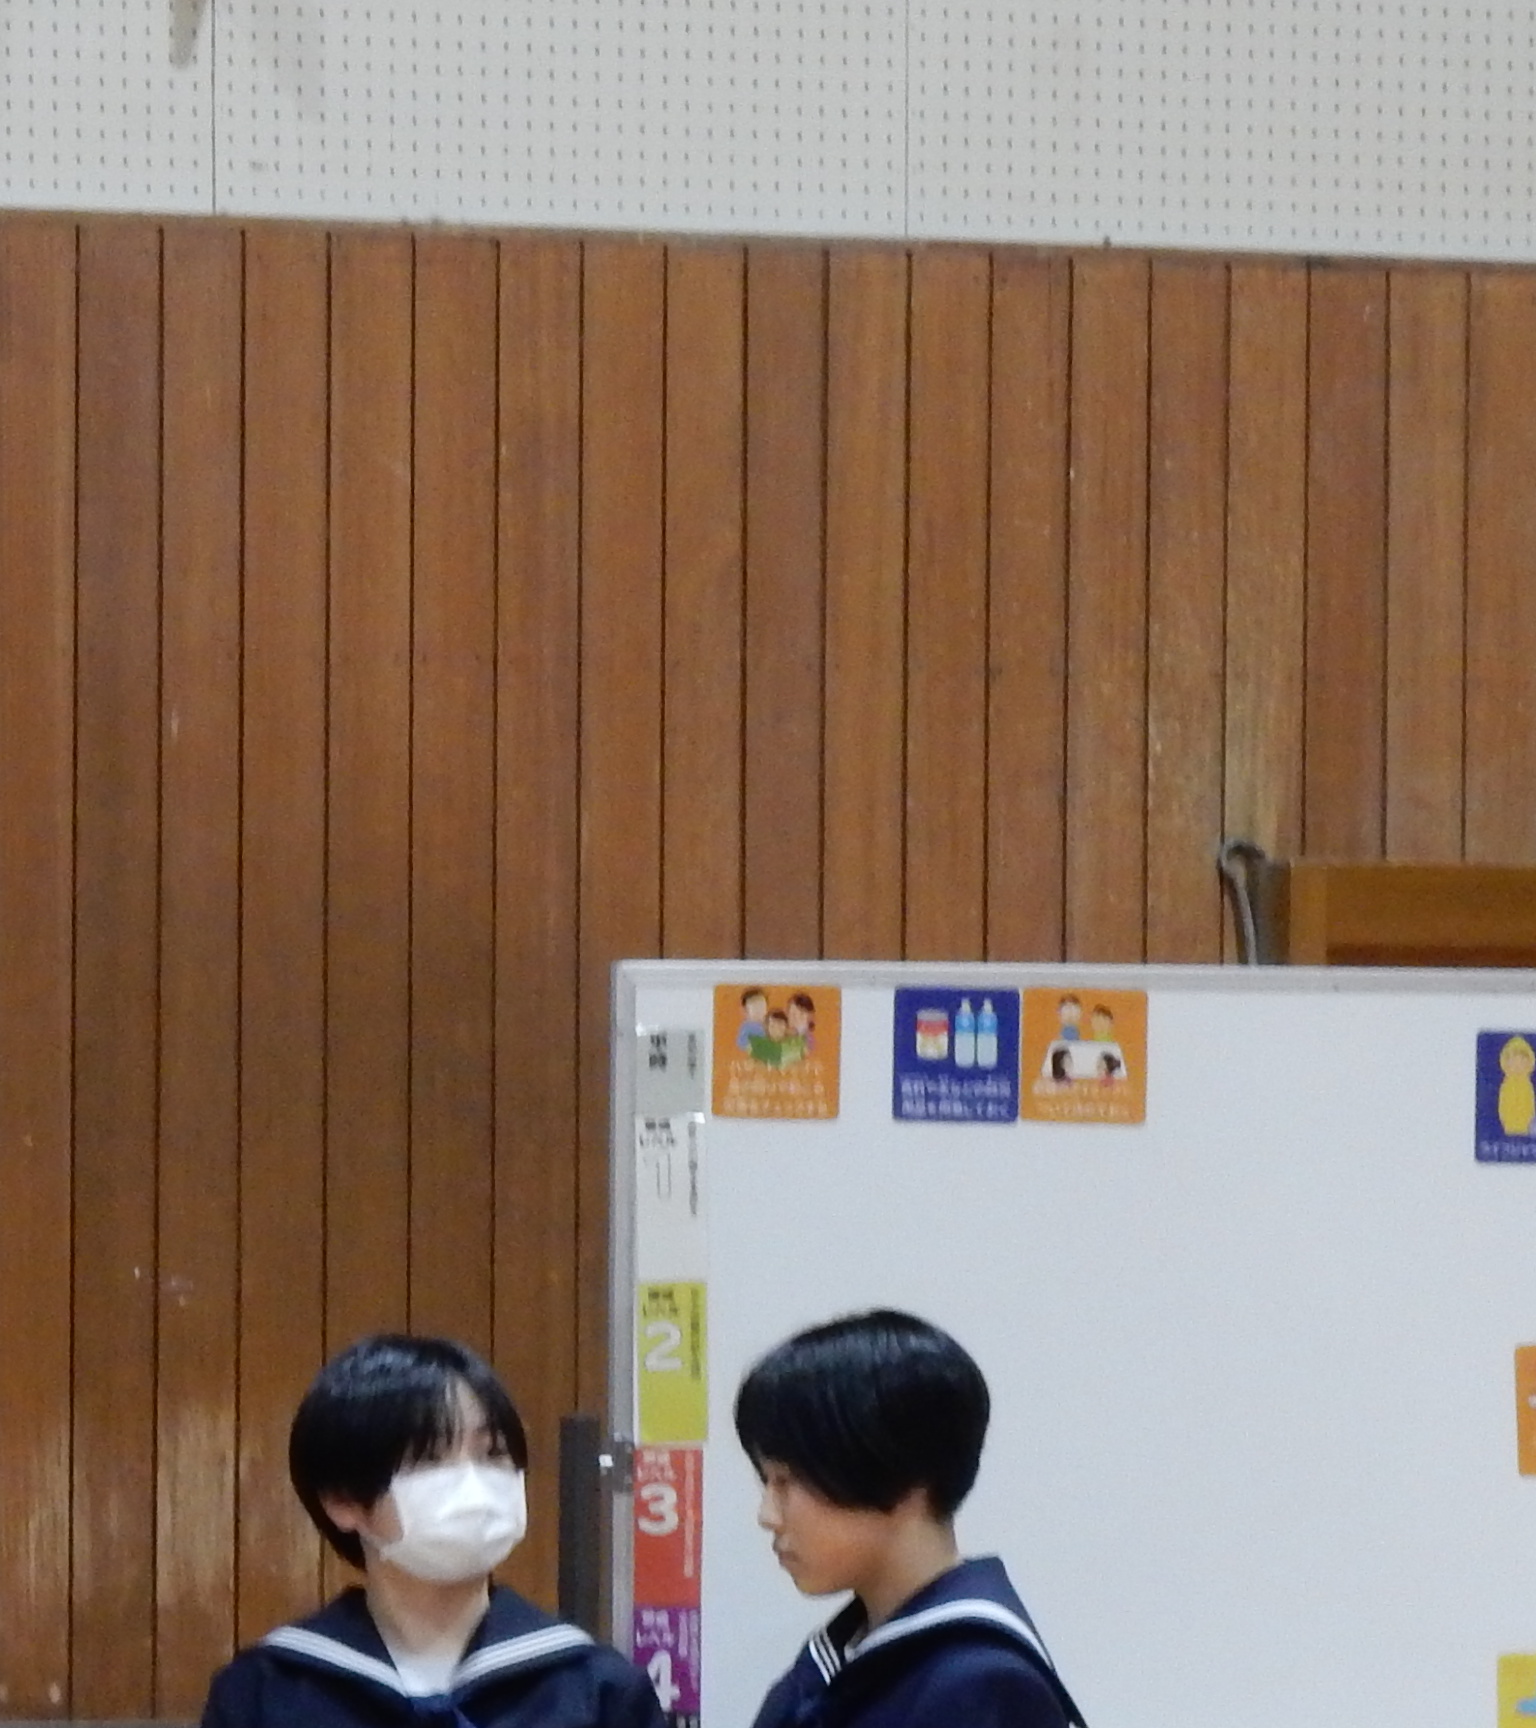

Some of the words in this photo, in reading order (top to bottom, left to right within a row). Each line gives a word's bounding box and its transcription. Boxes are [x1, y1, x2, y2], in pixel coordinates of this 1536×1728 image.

[645, 1319, 683, 1373] 2
[637, 1482, 679, 1536] 3
[647, 1649, 681, 1713] 4
